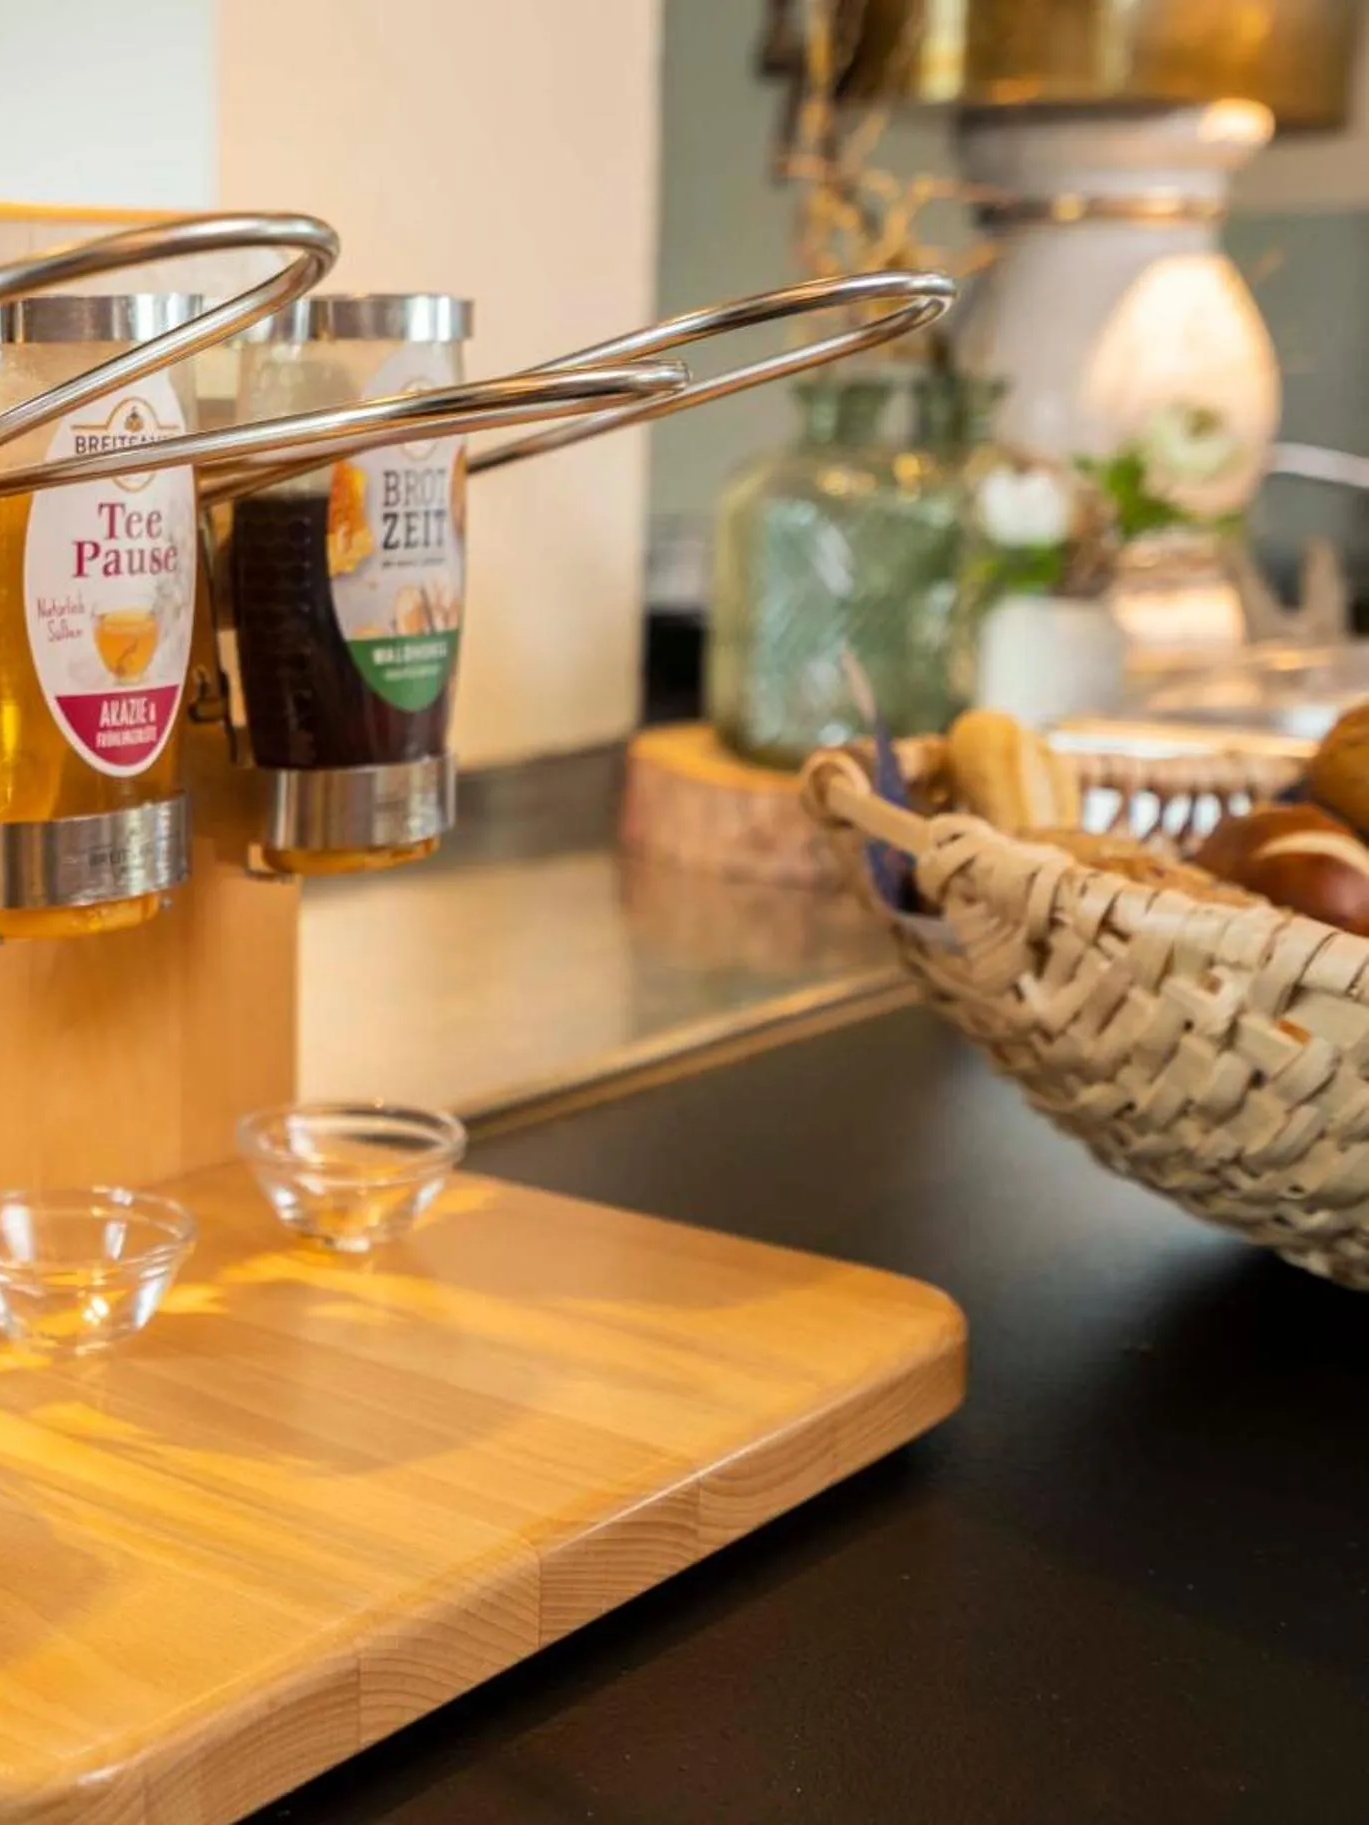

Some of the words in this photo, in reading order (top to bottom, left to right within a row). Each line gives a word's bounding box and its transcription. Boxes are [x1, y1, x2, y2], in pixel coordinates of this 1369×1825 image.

[383, 467, 447, 507] BROT
[97, 502, 163, 540] Tee
[382, 509, 447, 549] ZEIT
[72, 539, 179, 578] Pause
